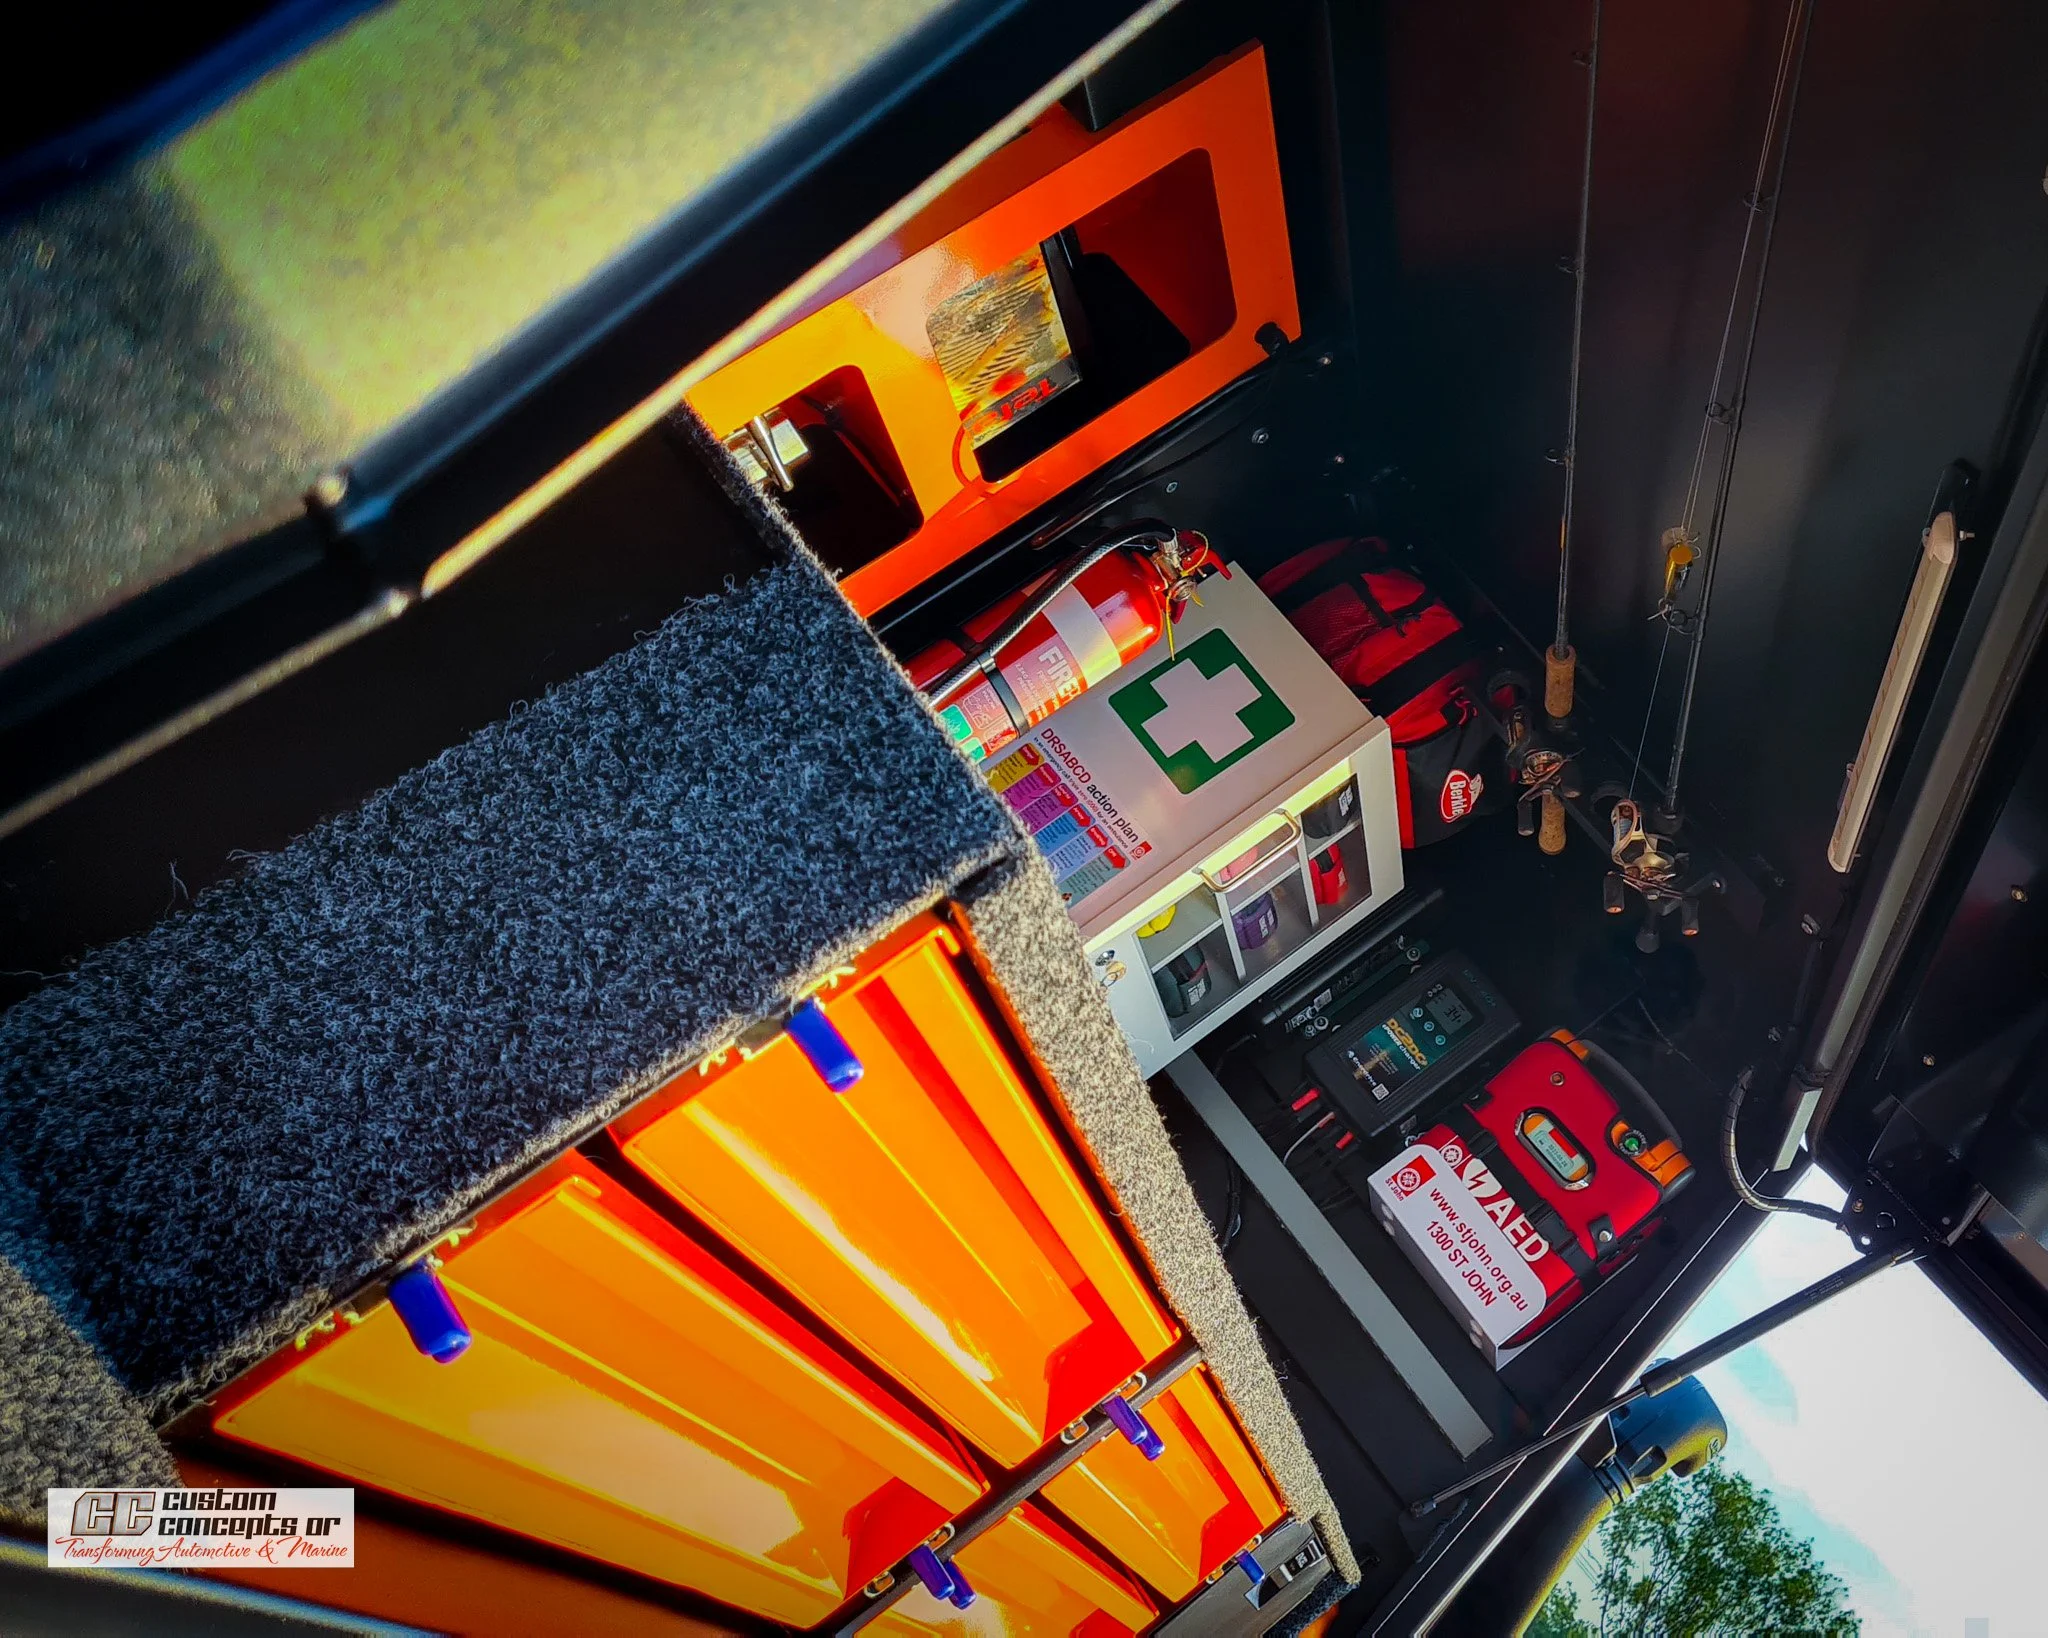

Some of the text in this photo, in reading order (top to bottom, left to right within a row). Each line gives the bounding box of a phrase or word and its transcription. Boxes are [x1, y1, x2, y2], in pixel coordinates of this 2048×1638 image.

[1039, 745, 1062, 771] emergency
[1060, 768, 1070, 779] call
[1077, 789, 1088, 801] zero
[1095, 811, 1104, 819] for
[1101, 817, 1108, 825] an
[1106, 823, 1129, 849] ambulance
[1041, 728, 1091, 784] DRSABCD
[1087, 784, 1118, 818] action
[1113, 817, 1138, 843] plan
[1450, 780, 1467, 816] Berkle
[1400, 1045, 1421, 1071] charger
[1384, 1176, 1406, 1201] St John
[1426, 1220, 1497, 1307] 1300 ST JOHN
[1430, 1188, 1529, 1311] www.stjohn.org.au
[1484, 1199, 1550, 1262] AED
